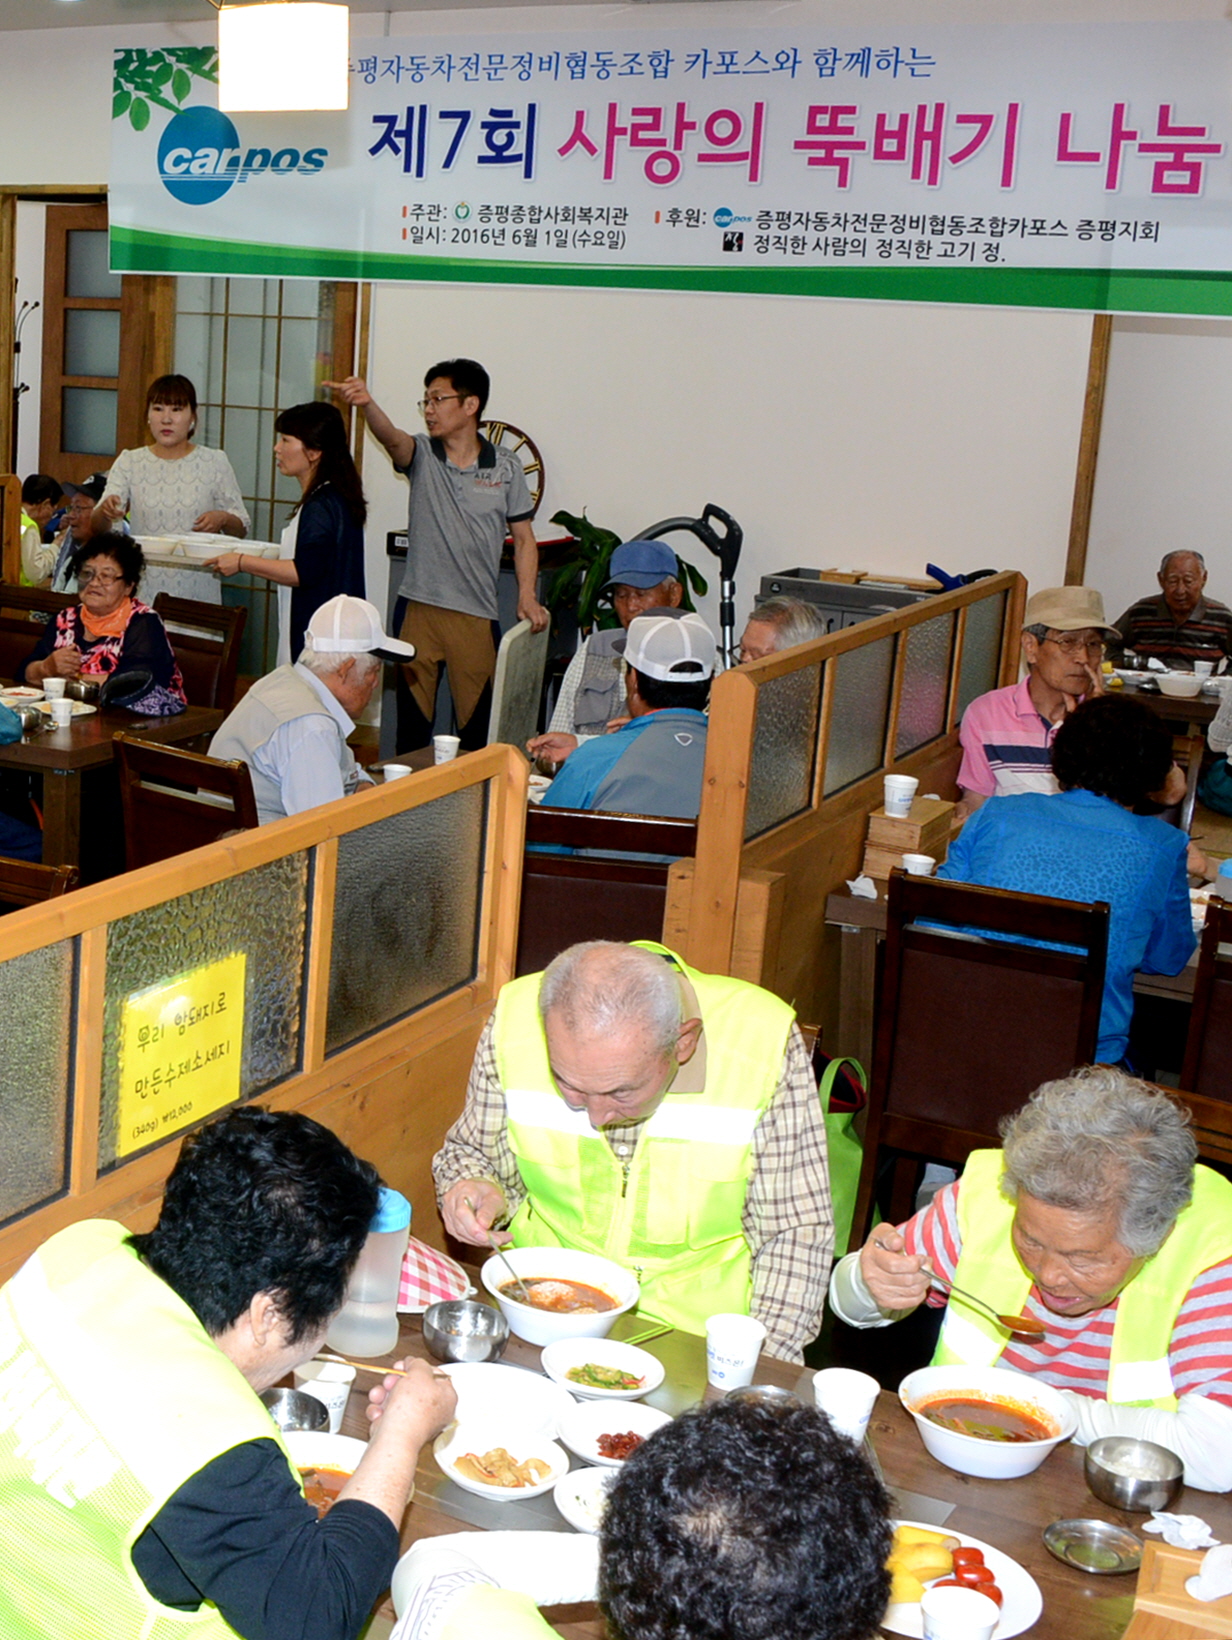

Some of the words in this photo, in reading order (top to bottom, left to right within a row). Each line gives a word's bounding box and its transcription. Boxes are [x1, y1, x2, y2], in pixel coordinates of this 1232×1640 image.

[348, 47, 674, 84] 평자동차전문정비협동조합
[684, 46, 802, 80] 카포스와
[812, 46, 937, 79] 함께하는
[368, 102, 538, 180] 제7회
[556, 101, 764, 186] 사랑의
[792, 101, 1020, 189] 뚝배기
[1055, 102, 1222, 194] 나눔
[409, 204, 448, 222] 주관:
[477, 204, 630, 227] 증평종합사회복지관
[665, 207, 708, 229] 후원:
[755, 209, 1069, 240] 증평자동차전문정비협동조합카포스
[1075, 218, 1161, 243] 증평지회
[409, 226, 447, 245] 일시:
[450, 226, 506, 247] 2016년
[511, 228, 538, 248] 6월
[753, 234, 808, 256] 정직한
[811, 236, 868, 258] 사람의
[875, 238, 933, 260] 정직한
[936, 240, 976, 262] 고기
[981, 241, 1006, 263] 정.
